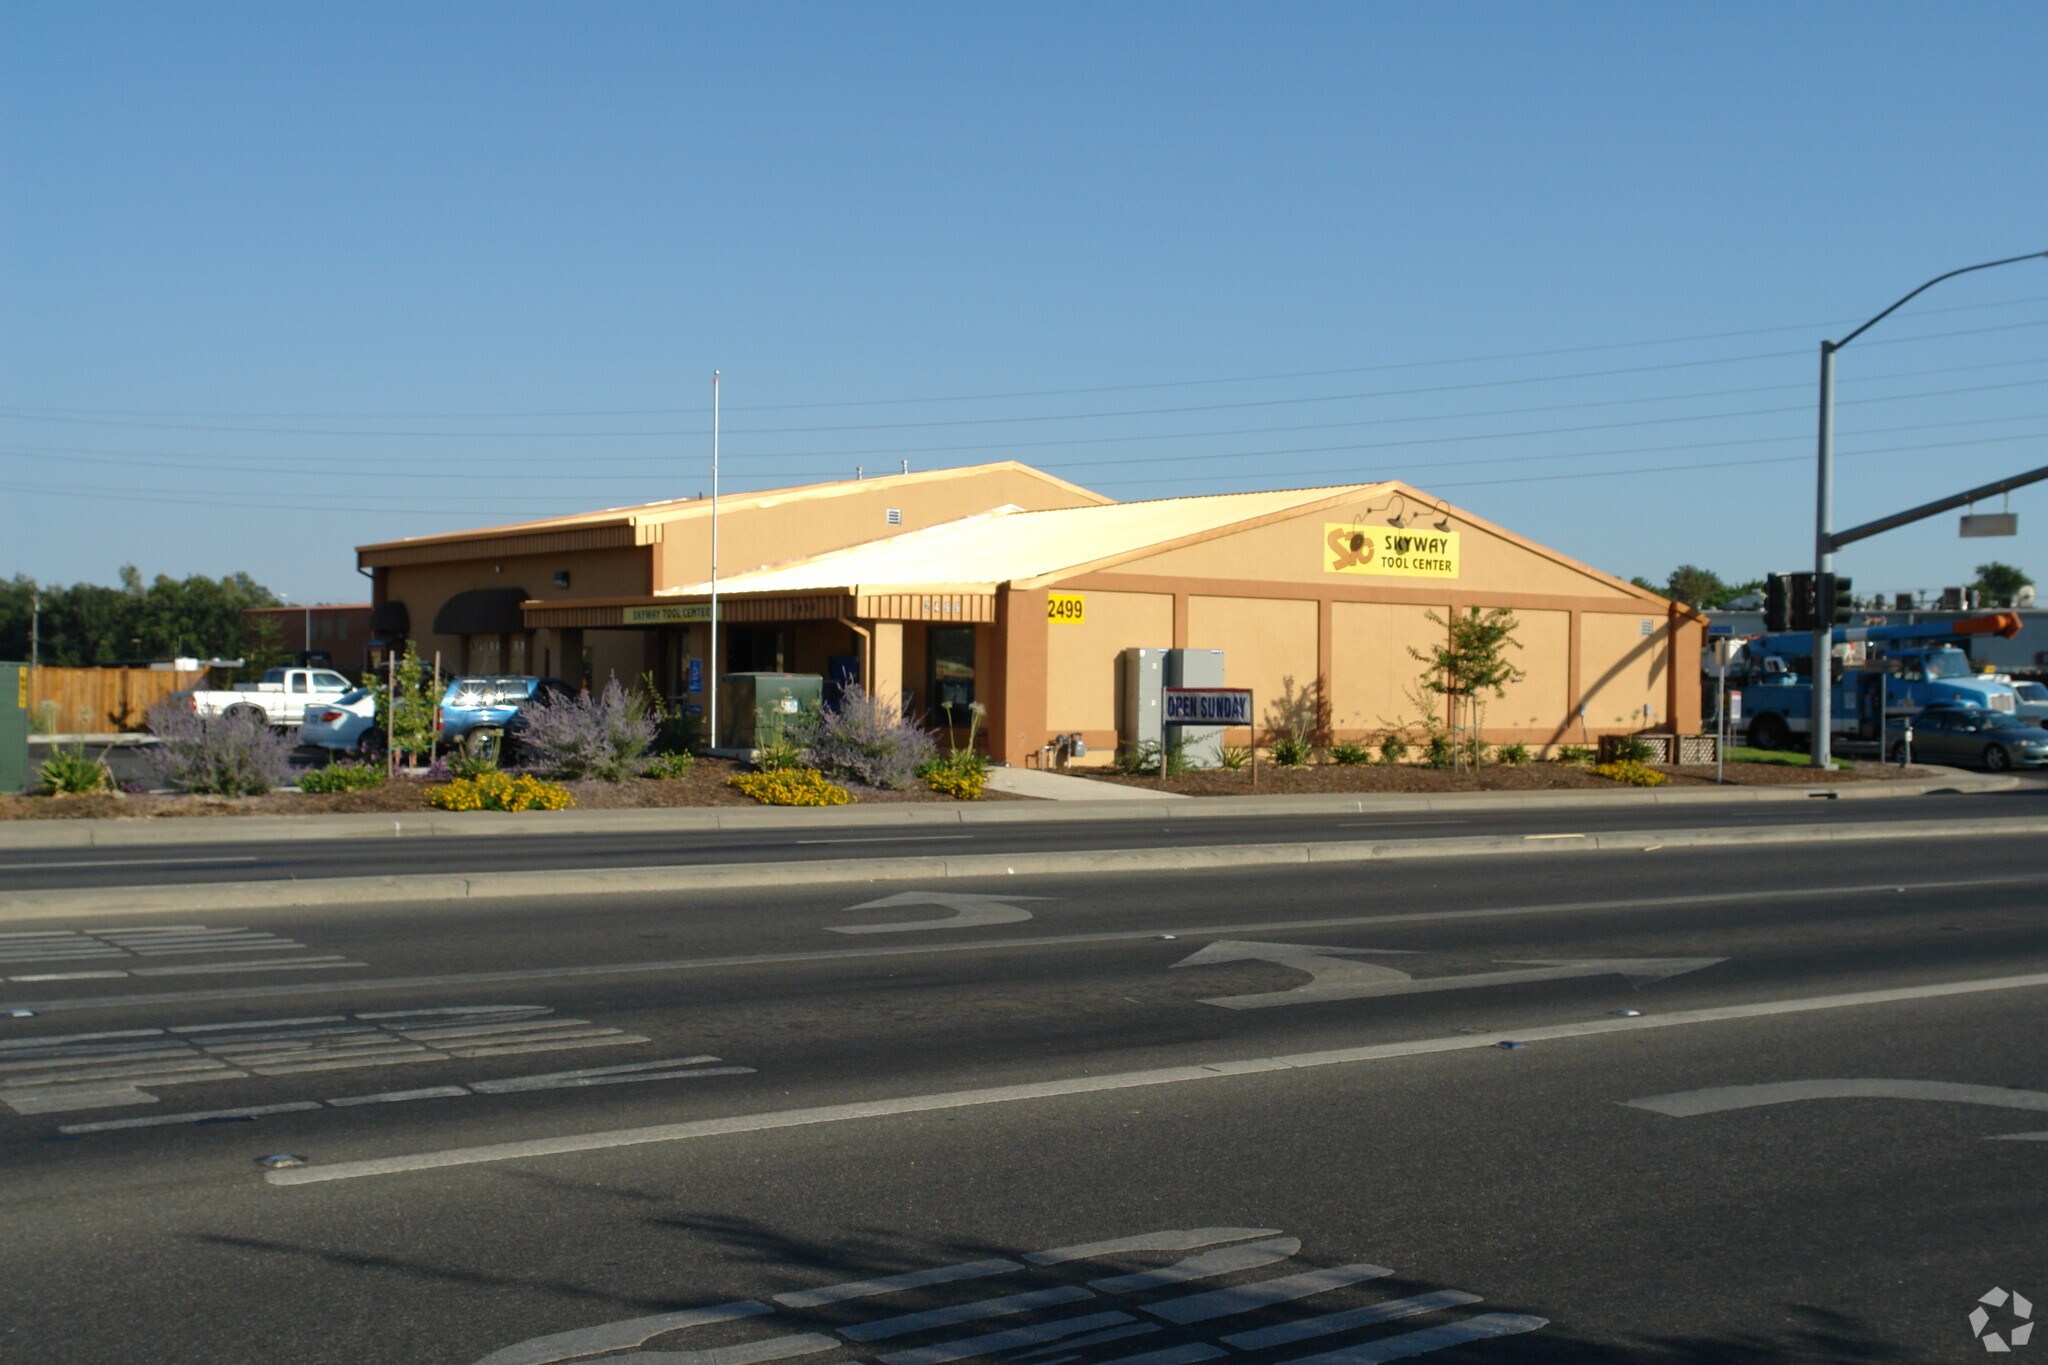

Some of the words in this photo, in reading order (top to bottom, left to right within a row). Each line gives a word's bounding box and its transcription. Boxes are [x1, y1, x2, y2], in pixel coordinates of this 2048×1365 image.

[1384, 535, 1448, 555] SKYWAY
[1381, 556, 1409, 569] TOOL
[1413, 558, 1452, 572] CENTER
[632, 609, 661, 620] SKYWAY
[662, 608, 682, 619] TOOL
[683, 606, 711, 619] CENTER
[1047, 600, 1083, 619] 2499
[1167, 696, 1197, 718] OPEN
[1200, 696, 1247, 719] SUNDAY
